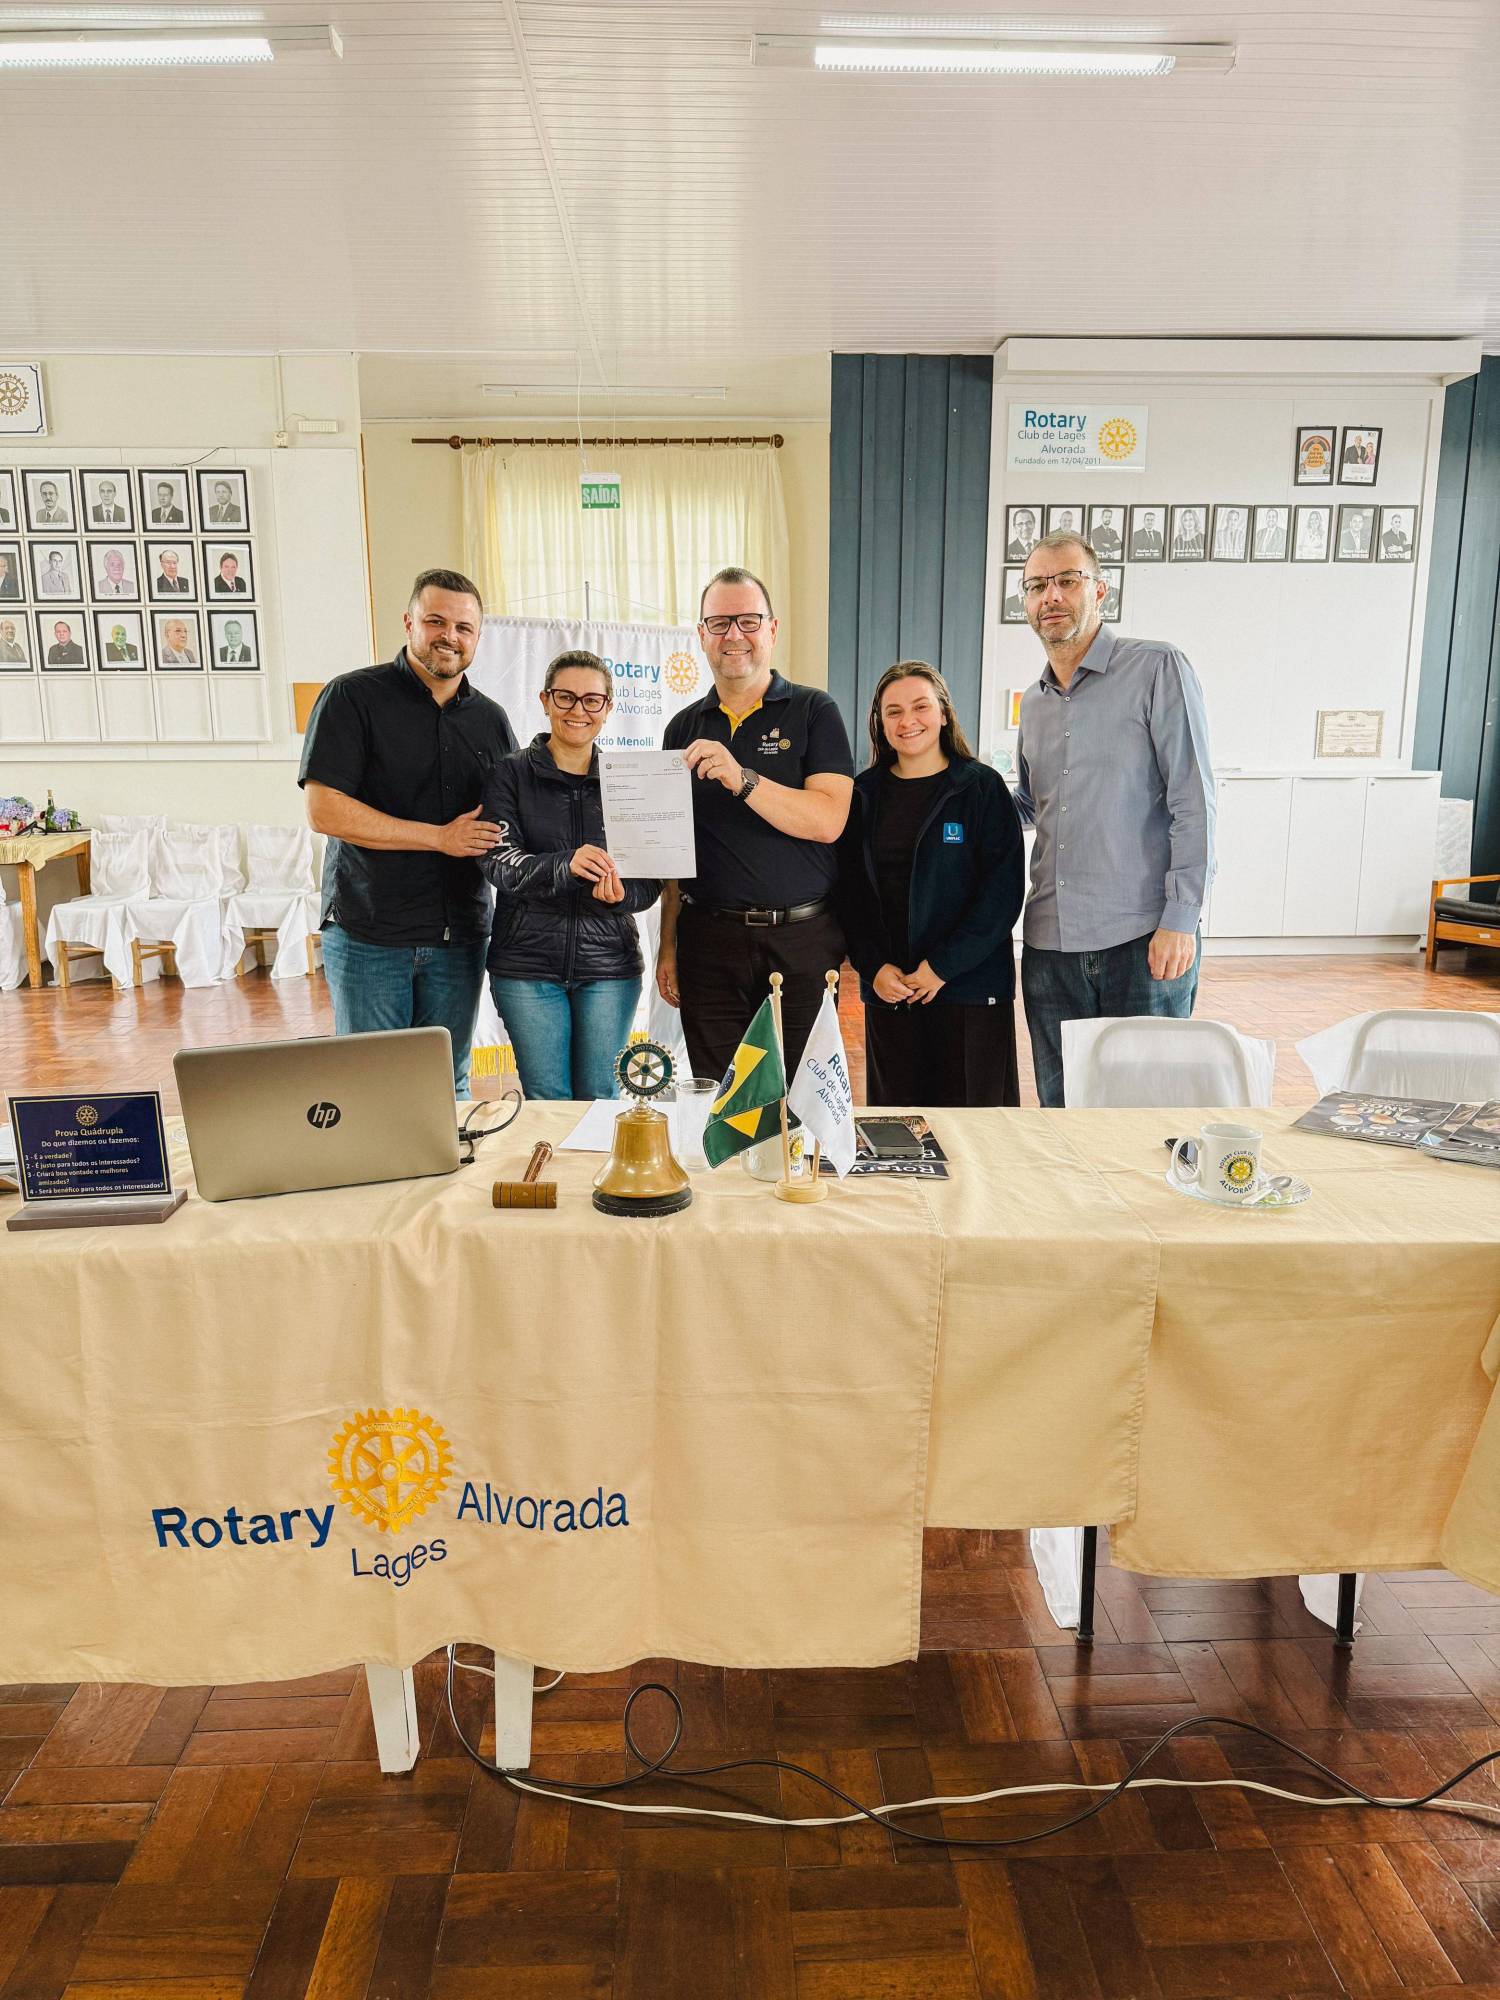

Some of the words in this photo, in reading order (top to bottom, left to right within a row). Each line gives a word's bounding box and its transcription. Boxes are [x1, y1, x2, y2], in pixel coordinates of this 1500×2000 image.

[1025, 410, 1087, 432] Rotary
[1018, 430, 1040, 440] Club
[1042, 430, 1055, 440] de
[1058, 431, 1086, 442] Lages
[1041, 444, 1086, 454] Alvorada
[1014, 457, 1046, 465] Fundado
[582, 485, 619, 504] SAÍDA
[633, 687, 662, 701] Lages
[616, 702, 663, 715] Alvorada
[617, 736, 654, 747] Menolli
[806, 1058, 828, 1081] Club
[826, 1079, 837, 1093] de
[816, 1087, 841, 1125] Alvorada
[312, 1102, 337, 1129] hp
[55, 1129, 78, 1137] Prova
[80, 1127, 123, 1137] Quádrupla
[1334, 1125, 1421, 1141] Rotary
[53, 1140, 67, 1148] que
[68, 1138, 97, 1147] dizemos
[44, 1152, 72, 1160] verdade?
[55, 1169, 68, 1177] boa
[69, 1168, 94, 1176] vontade
[852, 1164, 936, 1174] Rotary
[53, 1186, 80, 1194] benéfico
[95, 1184, 113, 1192] todos
[122, 1181, 164, 1190] interessados?
[1219, 1180, 1255, 1194] ALVORADA
[151, 1504, 335, 1549] Rotary
[457, 1481, 630, 1532] Alvorada
[351, 1537, 448, 1588] Lages
